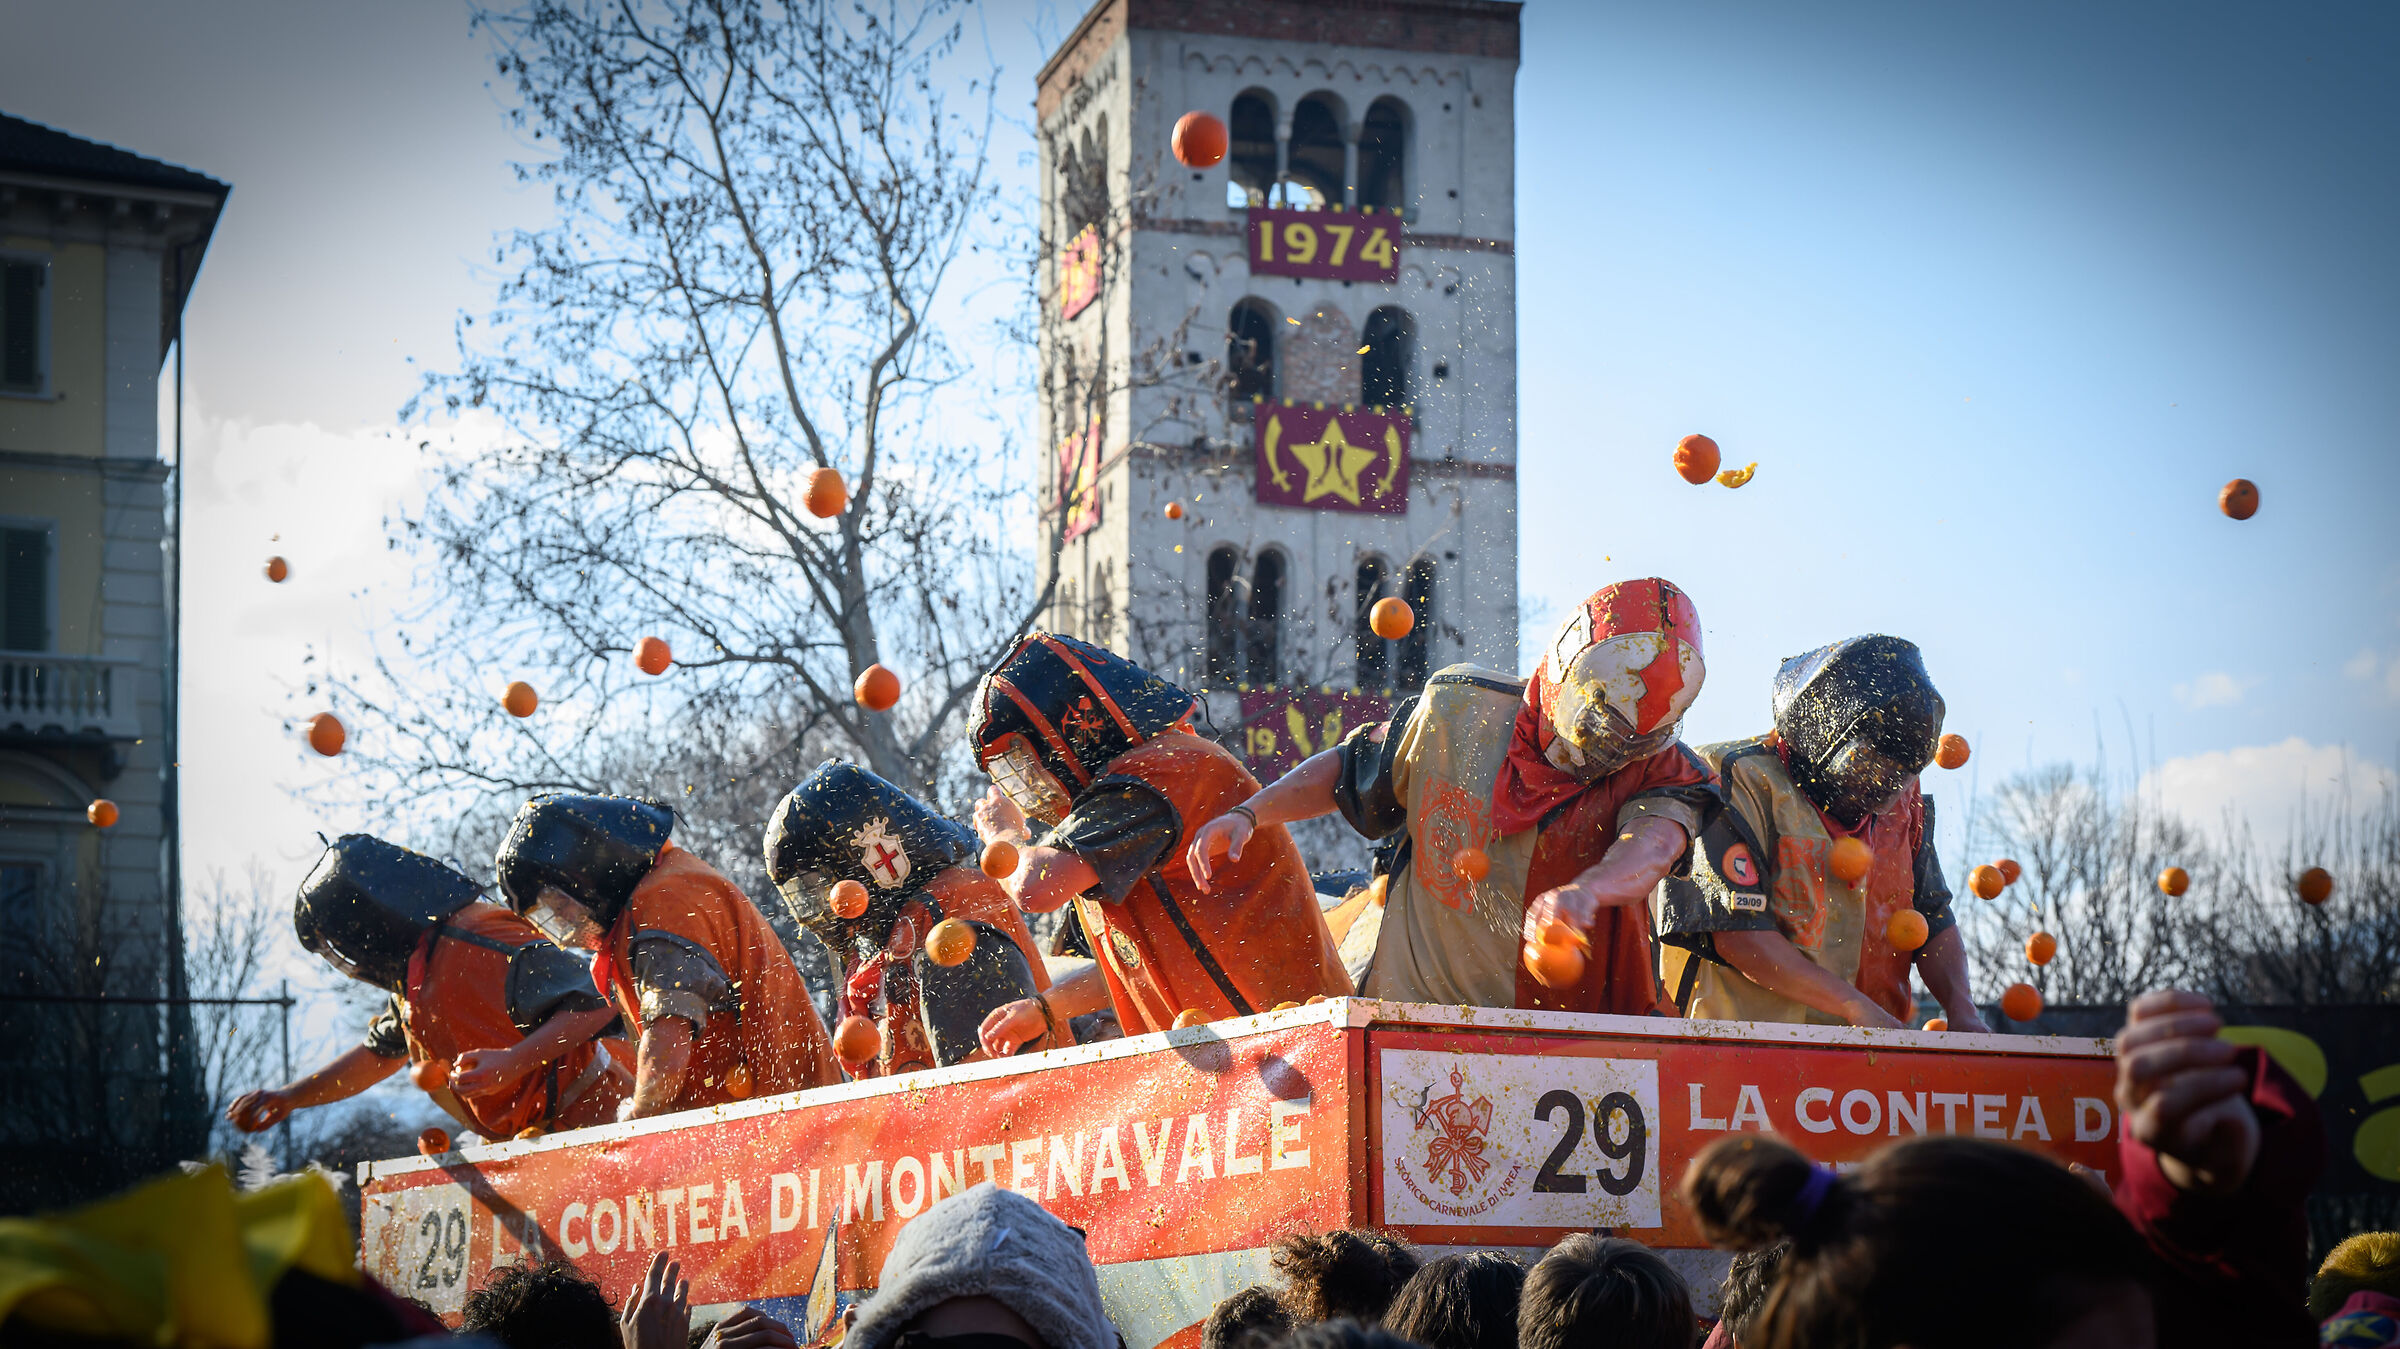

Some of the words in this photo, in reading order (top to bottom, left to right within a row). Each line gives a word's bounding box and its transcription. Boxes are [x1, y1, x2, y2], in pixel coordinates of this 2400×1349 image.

[1260, 221, 1393, 268] 1974
[1247, 727, 1276, 757] 19
[1736, 896, 1762, 907] 29/09
[1532, 1089, 1647, 1196] 29
[1687, 1083, 1774, 1132] LA
[1795, 1087, 2052, 1142] CONTEA
[2073, 1097, 2123, 1144] D
[490, 1209, 545, 1270] LA
[560, 1179, 750, 1259] CONTEA
[769, 1170, 820, 1234] DI
[842, 1093, 1312, 1225] MONTENAVALE
[1394, 1156, 1428, 1205] STORICO
[1428, 1198, 1488, 1217] CARNEVALE
[1487, 1194, 1500, 1207] DI
[1498, 1164, 1522, 1197] IVREA
[417, 1207, 467, 1290] 29
